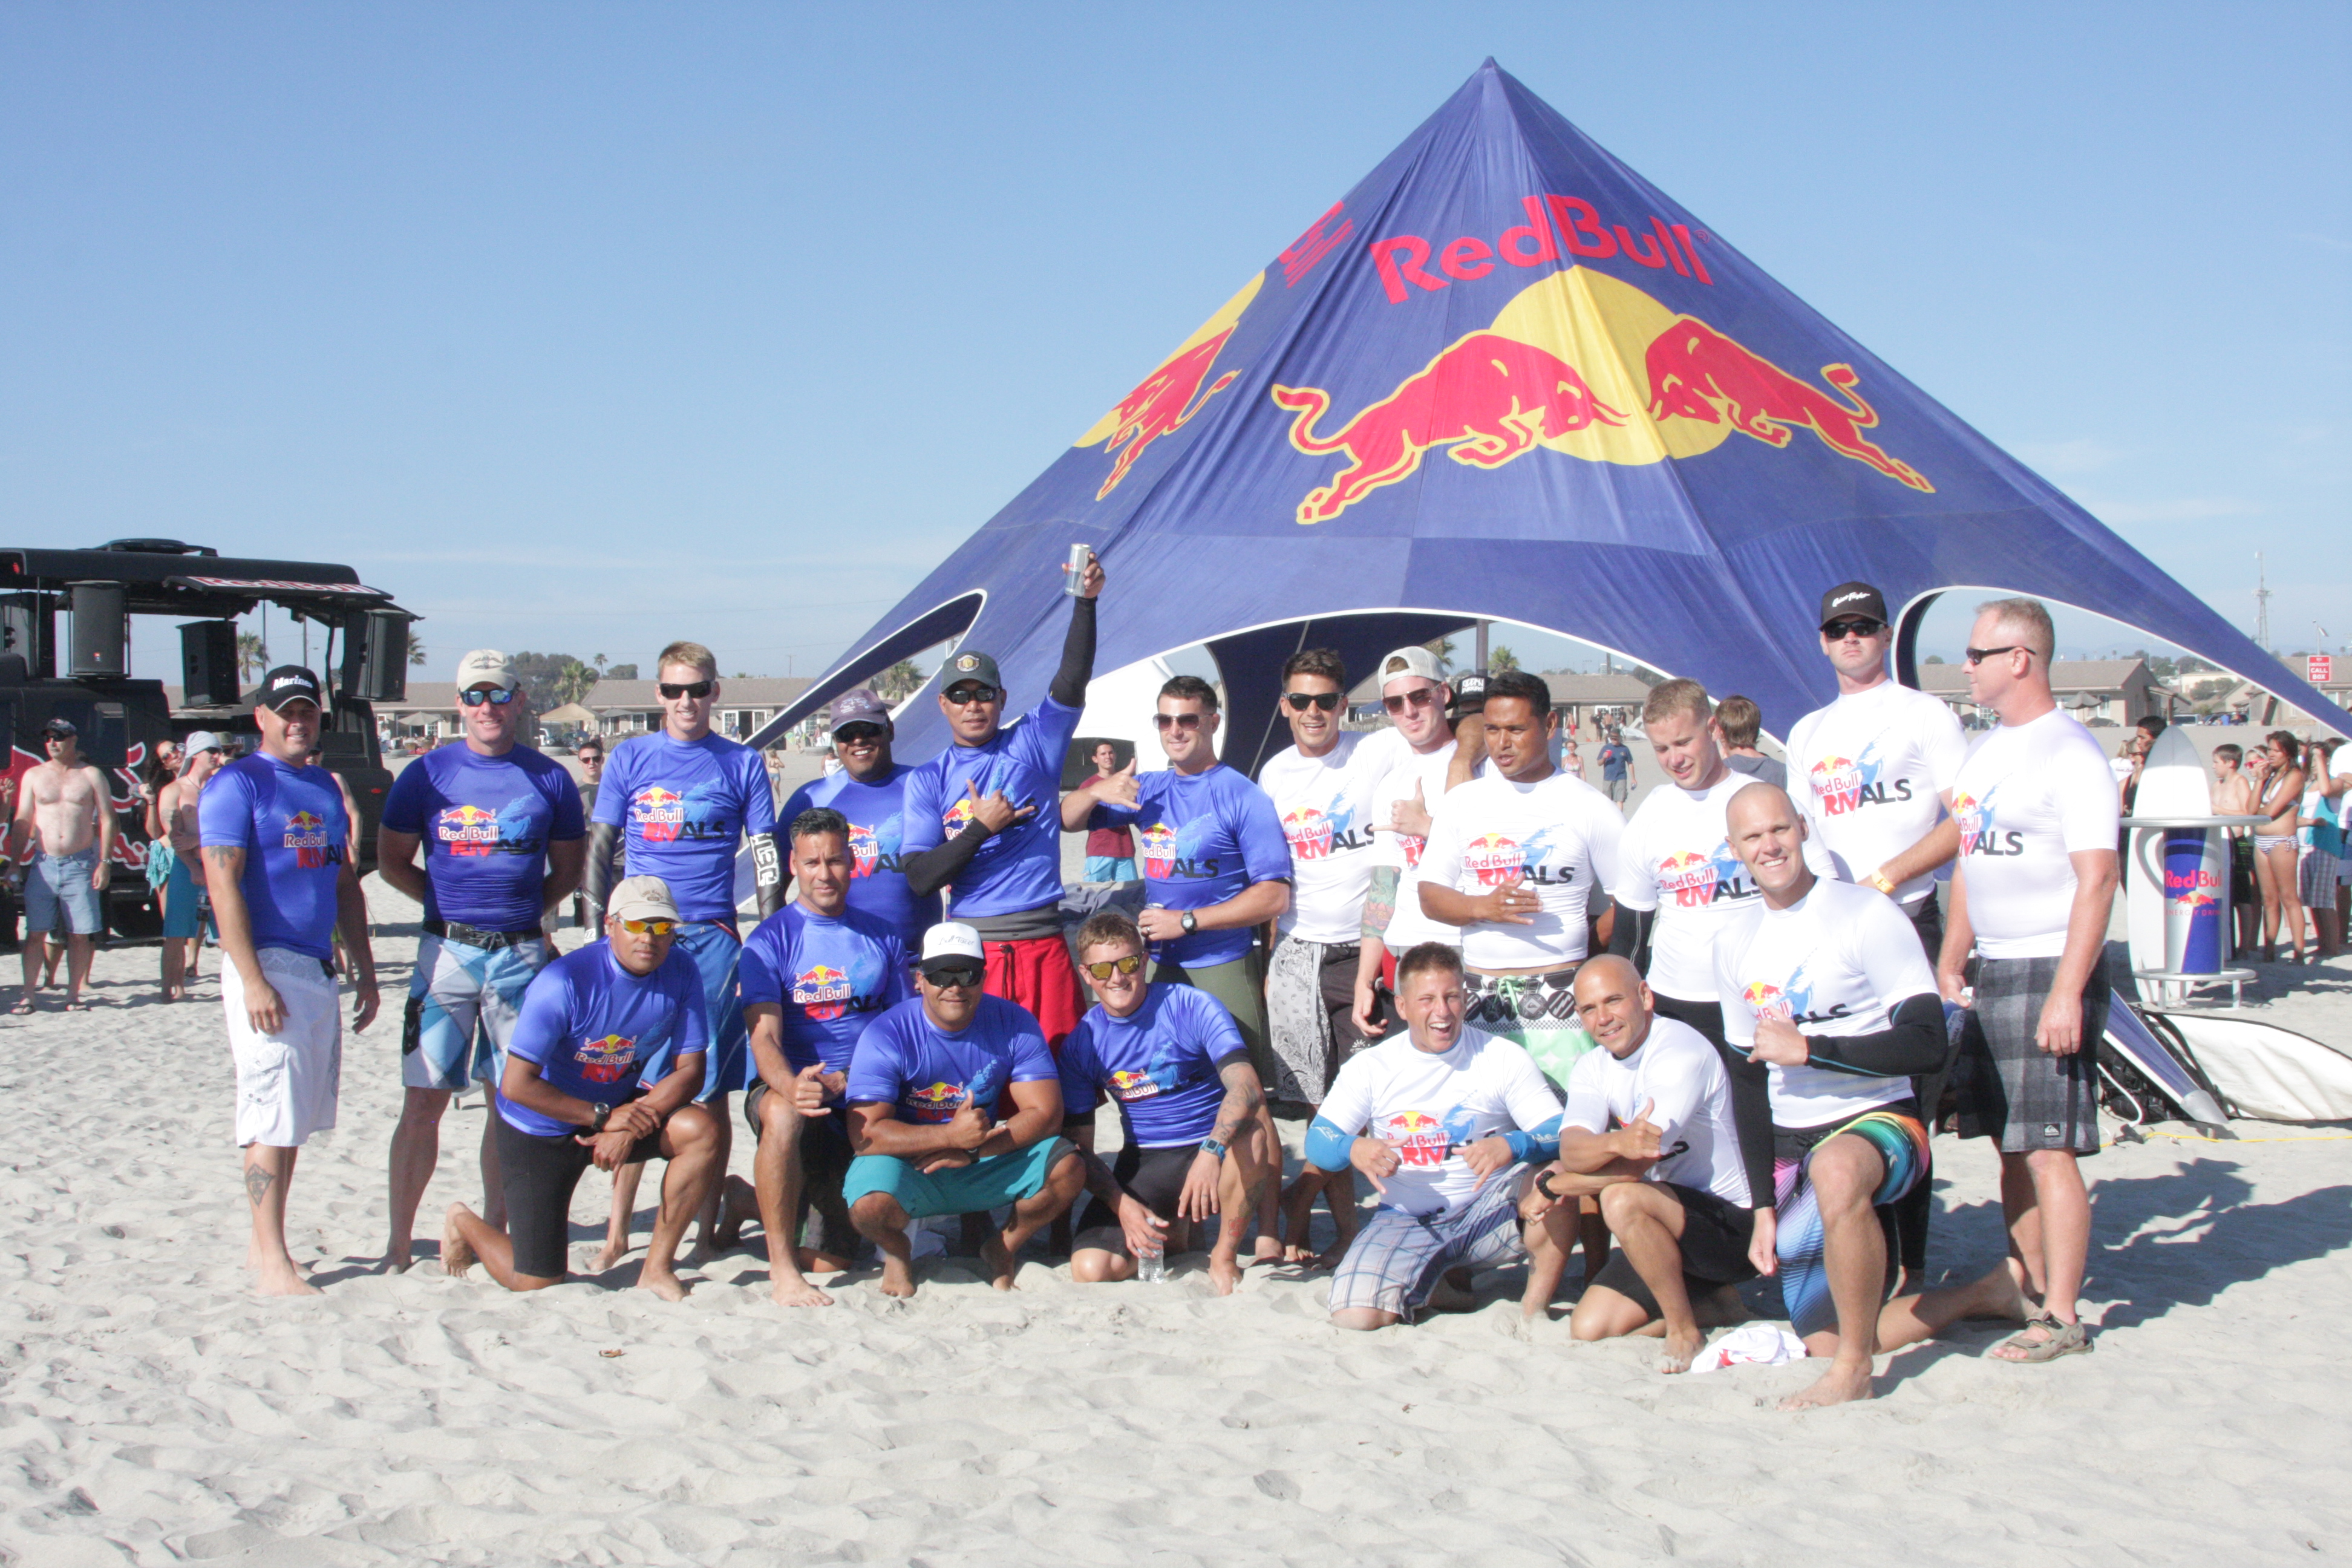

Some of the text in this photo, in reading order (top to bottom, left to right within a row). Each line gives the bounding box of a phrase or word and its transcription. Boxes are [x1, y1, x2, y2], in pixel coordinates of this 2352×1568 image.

[272, 675, 313, 691] Marines
[1823, 779, 1912, 817] RIVALS
[642, 820, 726, 842] RIVALS
[1146, 858, 1220, 879] RIVALS
[1476, 864, 1575, 886] RIVALS
